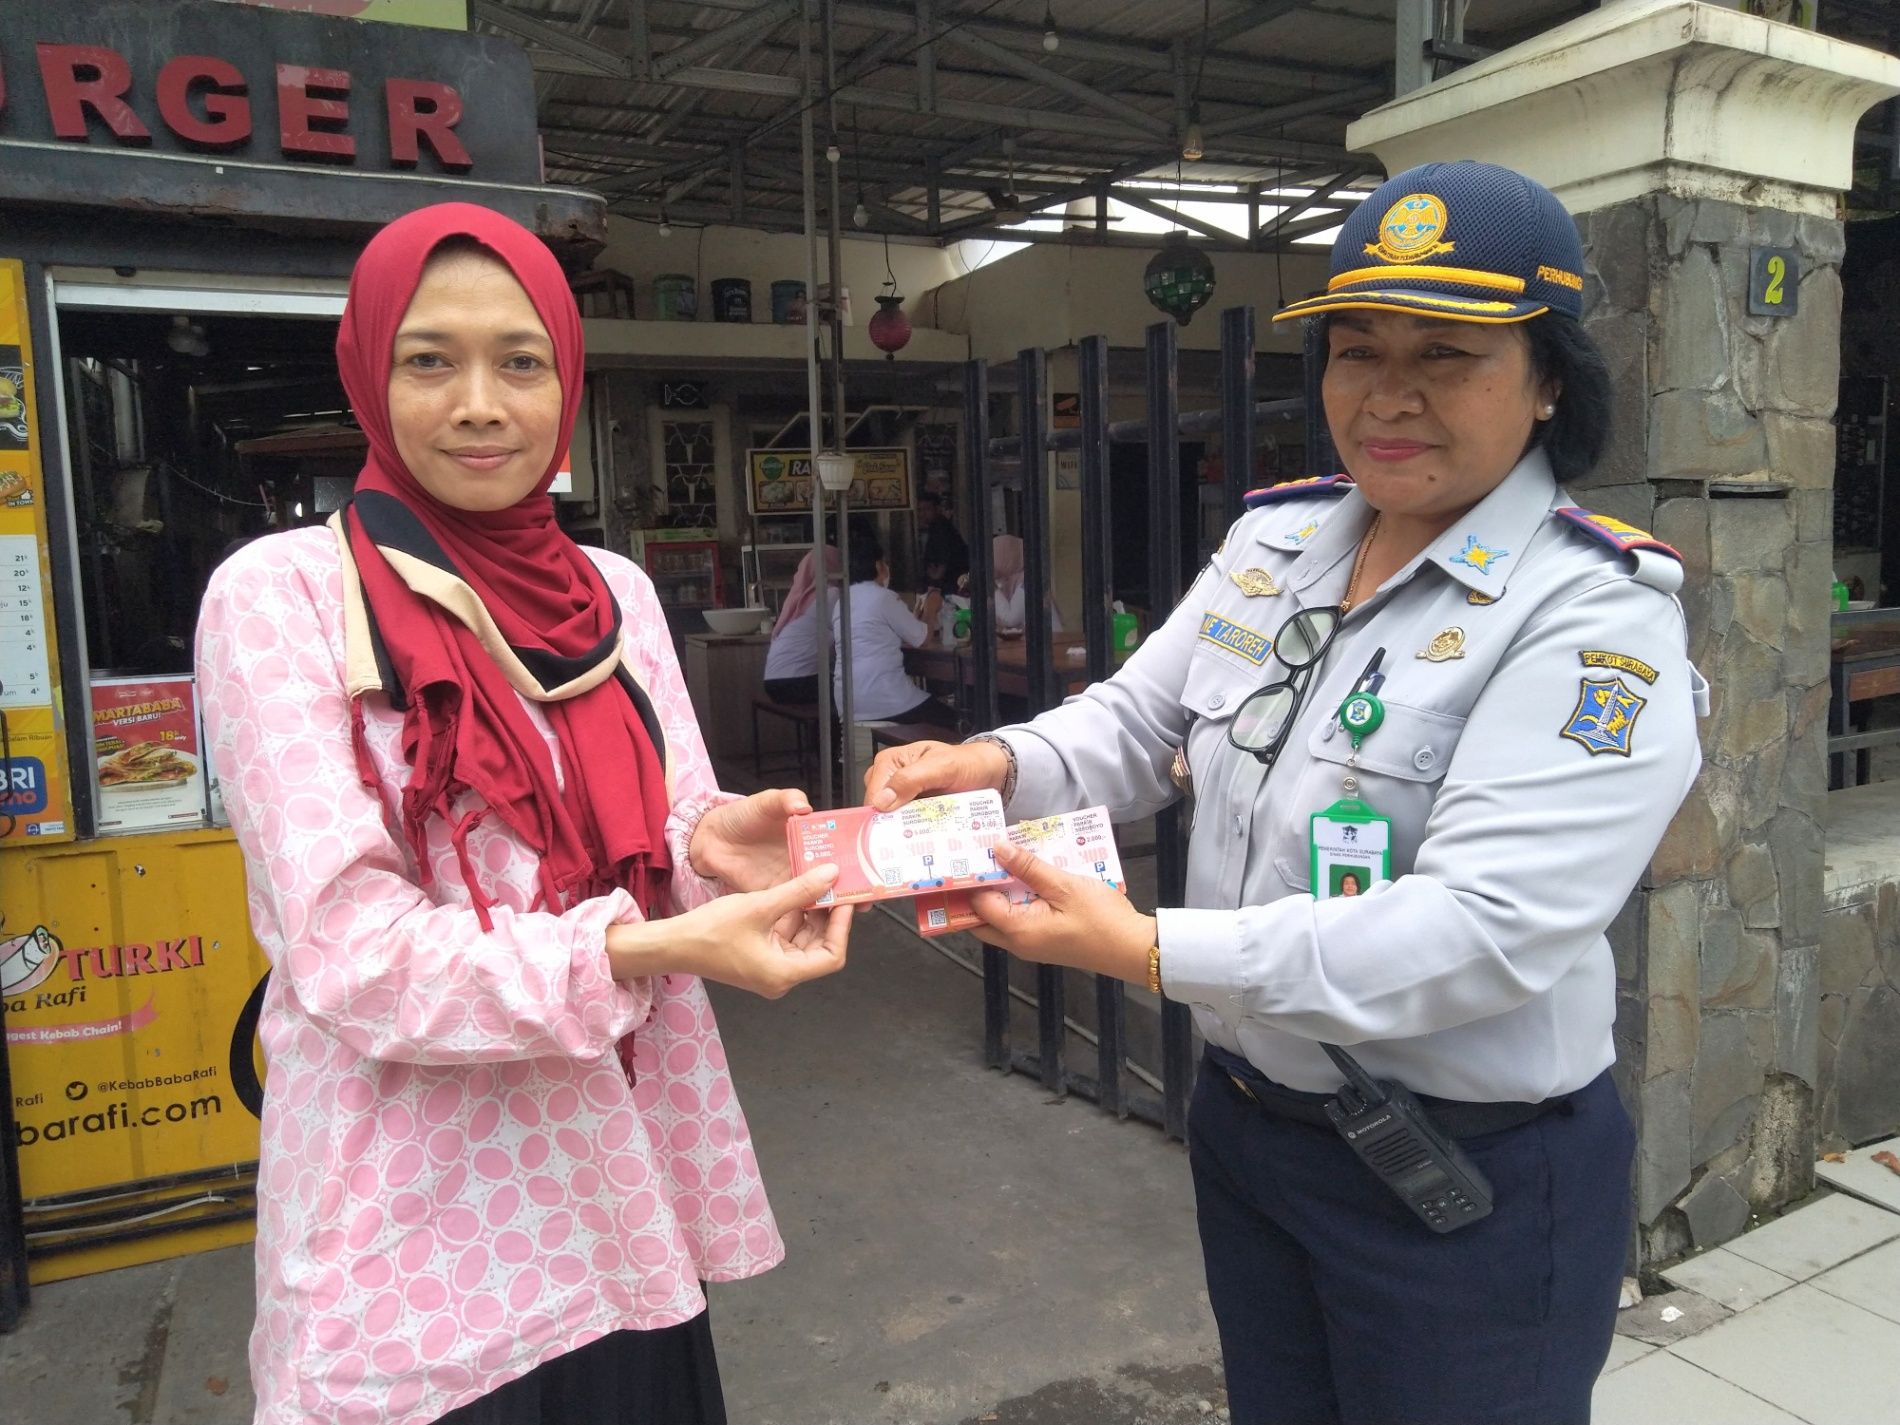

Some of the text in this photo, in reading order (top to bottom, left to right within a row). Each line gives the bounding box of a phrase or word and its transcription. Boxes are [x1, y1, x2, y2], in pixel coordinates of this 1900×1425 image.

[0, 41, 474, 171] RGER
[1765, 255, 1785, 304] 2
[1215, 621, 1268, 659] TAROREH
[1619, 656, 1656, 682] SURABAYA
[94, 697, 181, 721] MARTABABA
[113, 716, 136, 726] VERSI
[61, 935, 204, 982] TURKI
[35, 985, 87, 1010] Rafi
[40, 1026, 80, 1041] Kebab
[82, 1020, 123, 1037] Chain!
[16, 1065, 218, 1108] Rafi @KebabBabaRafi
[1357, 1114, 1392, 1134] MOTOROLA
